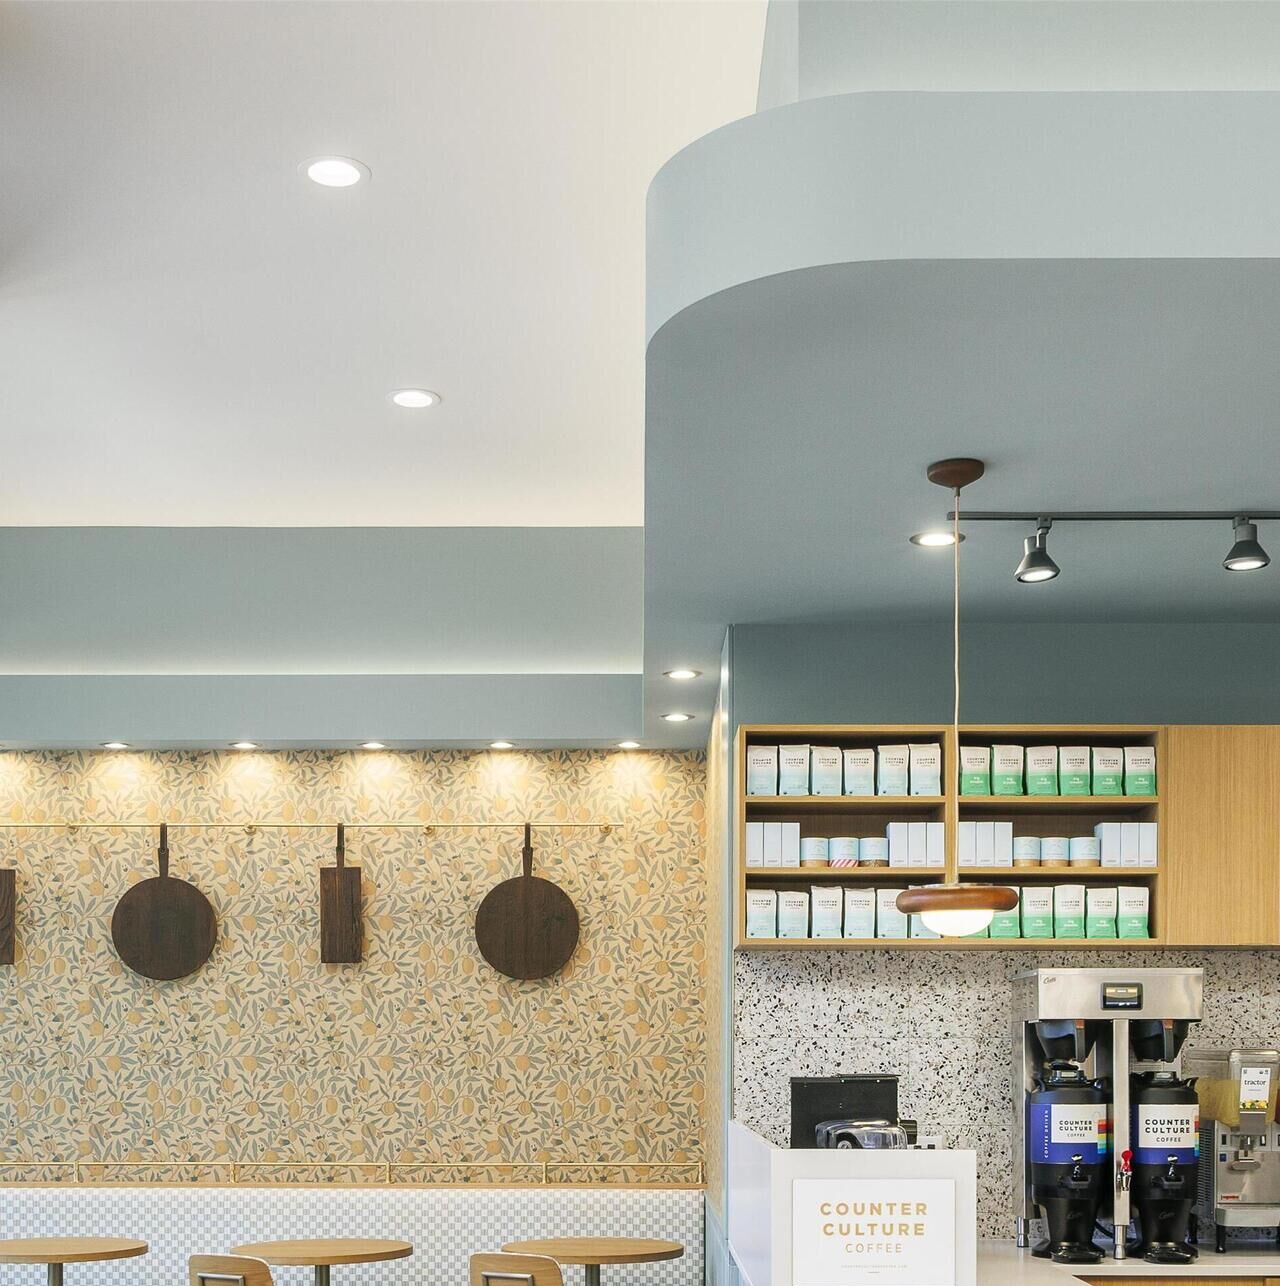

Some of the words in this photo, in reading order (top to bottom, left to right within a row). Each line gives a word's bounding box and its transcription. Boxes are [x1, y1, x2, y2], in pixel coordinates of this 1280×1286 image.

[820, 1203, 928, 1216] COUNTER
[823, 1223, 925, 1236] CULTURE
[845, 1243, 903, 1253] COFFEE
